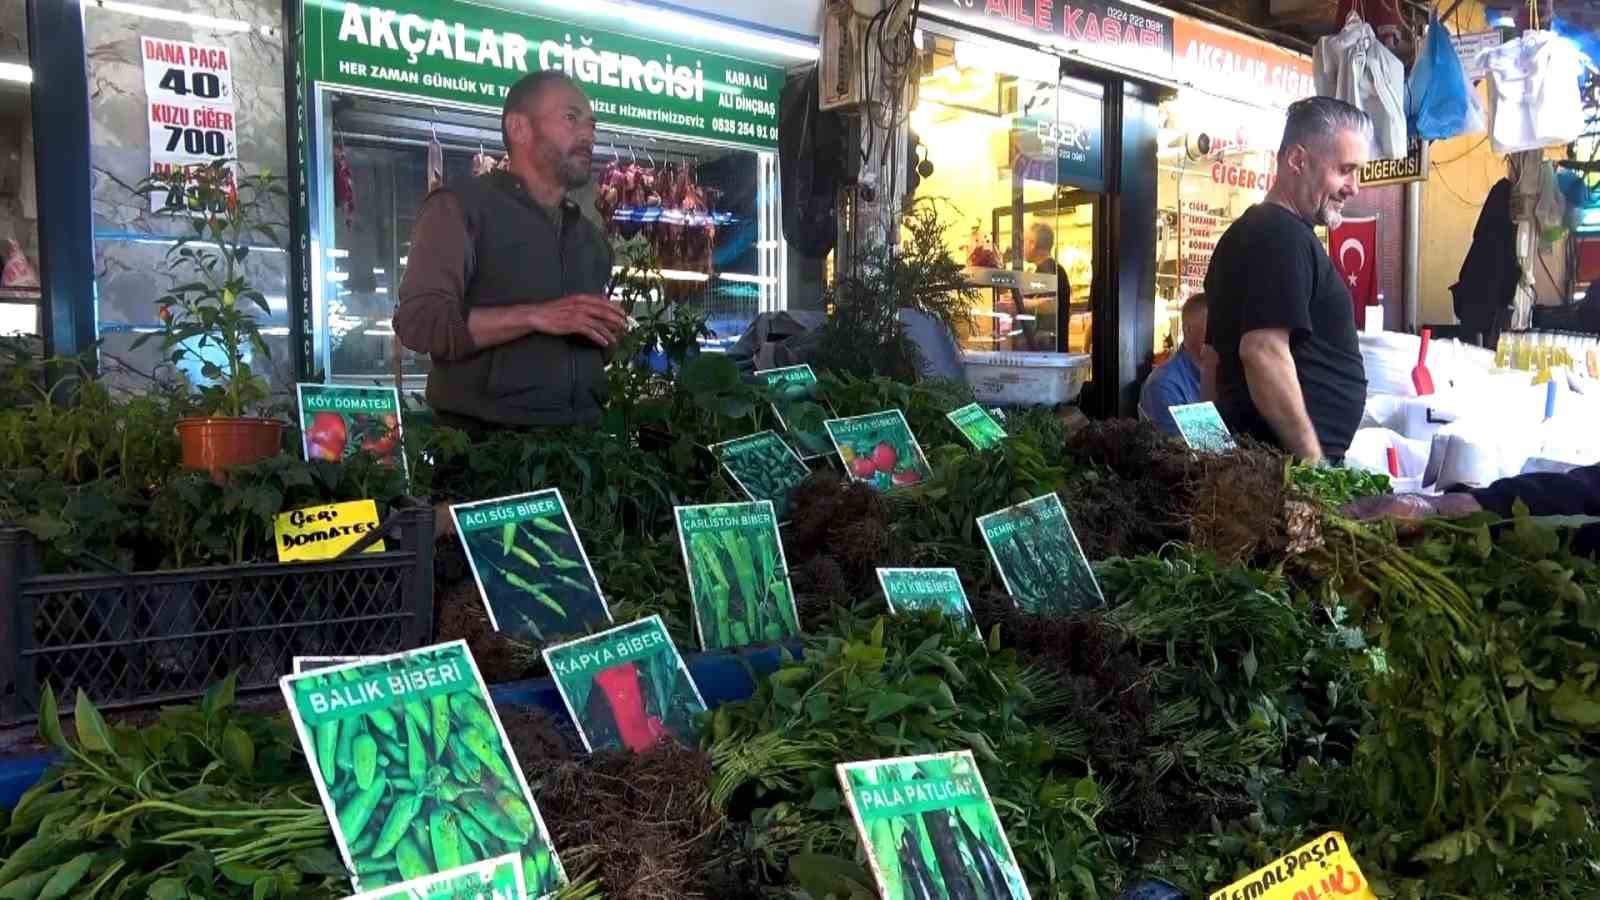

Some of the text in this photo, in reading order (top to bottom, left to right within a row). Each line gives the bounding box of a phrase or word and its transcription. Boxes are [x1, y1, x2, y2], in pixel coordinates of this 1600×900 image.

[144, 40, 229, 71] DANA PAÇA
[338, 2, 704, 103] AKÇALAR CİĞERCİSİ
[339, 60, 367, 77] HER
[370, 66, 419, 84] ZAMAN
[423, 72, 477, 94] GÜNLÜK
[480, 84, 496, 96] VE
[619, 103, 705, 129] HİZMETİNİZDEYİZ
[725, 69, 768, 91] KARA ALİ
[151, 104, 233, 130] KUZU CİĞER
[735, 94, 776, 119] DİNÇBAŞ
[307, 395, 392, 409] KÖY DOMATESİ
[466, 500, 556, 526] ACI SÜS BİBER
[555, 630, 664, 676] KAPYA BİBER
[309, 658, 463, 714] BALIK BİBERİ
[860, 777, 977, 810] PALA PATLICAN
